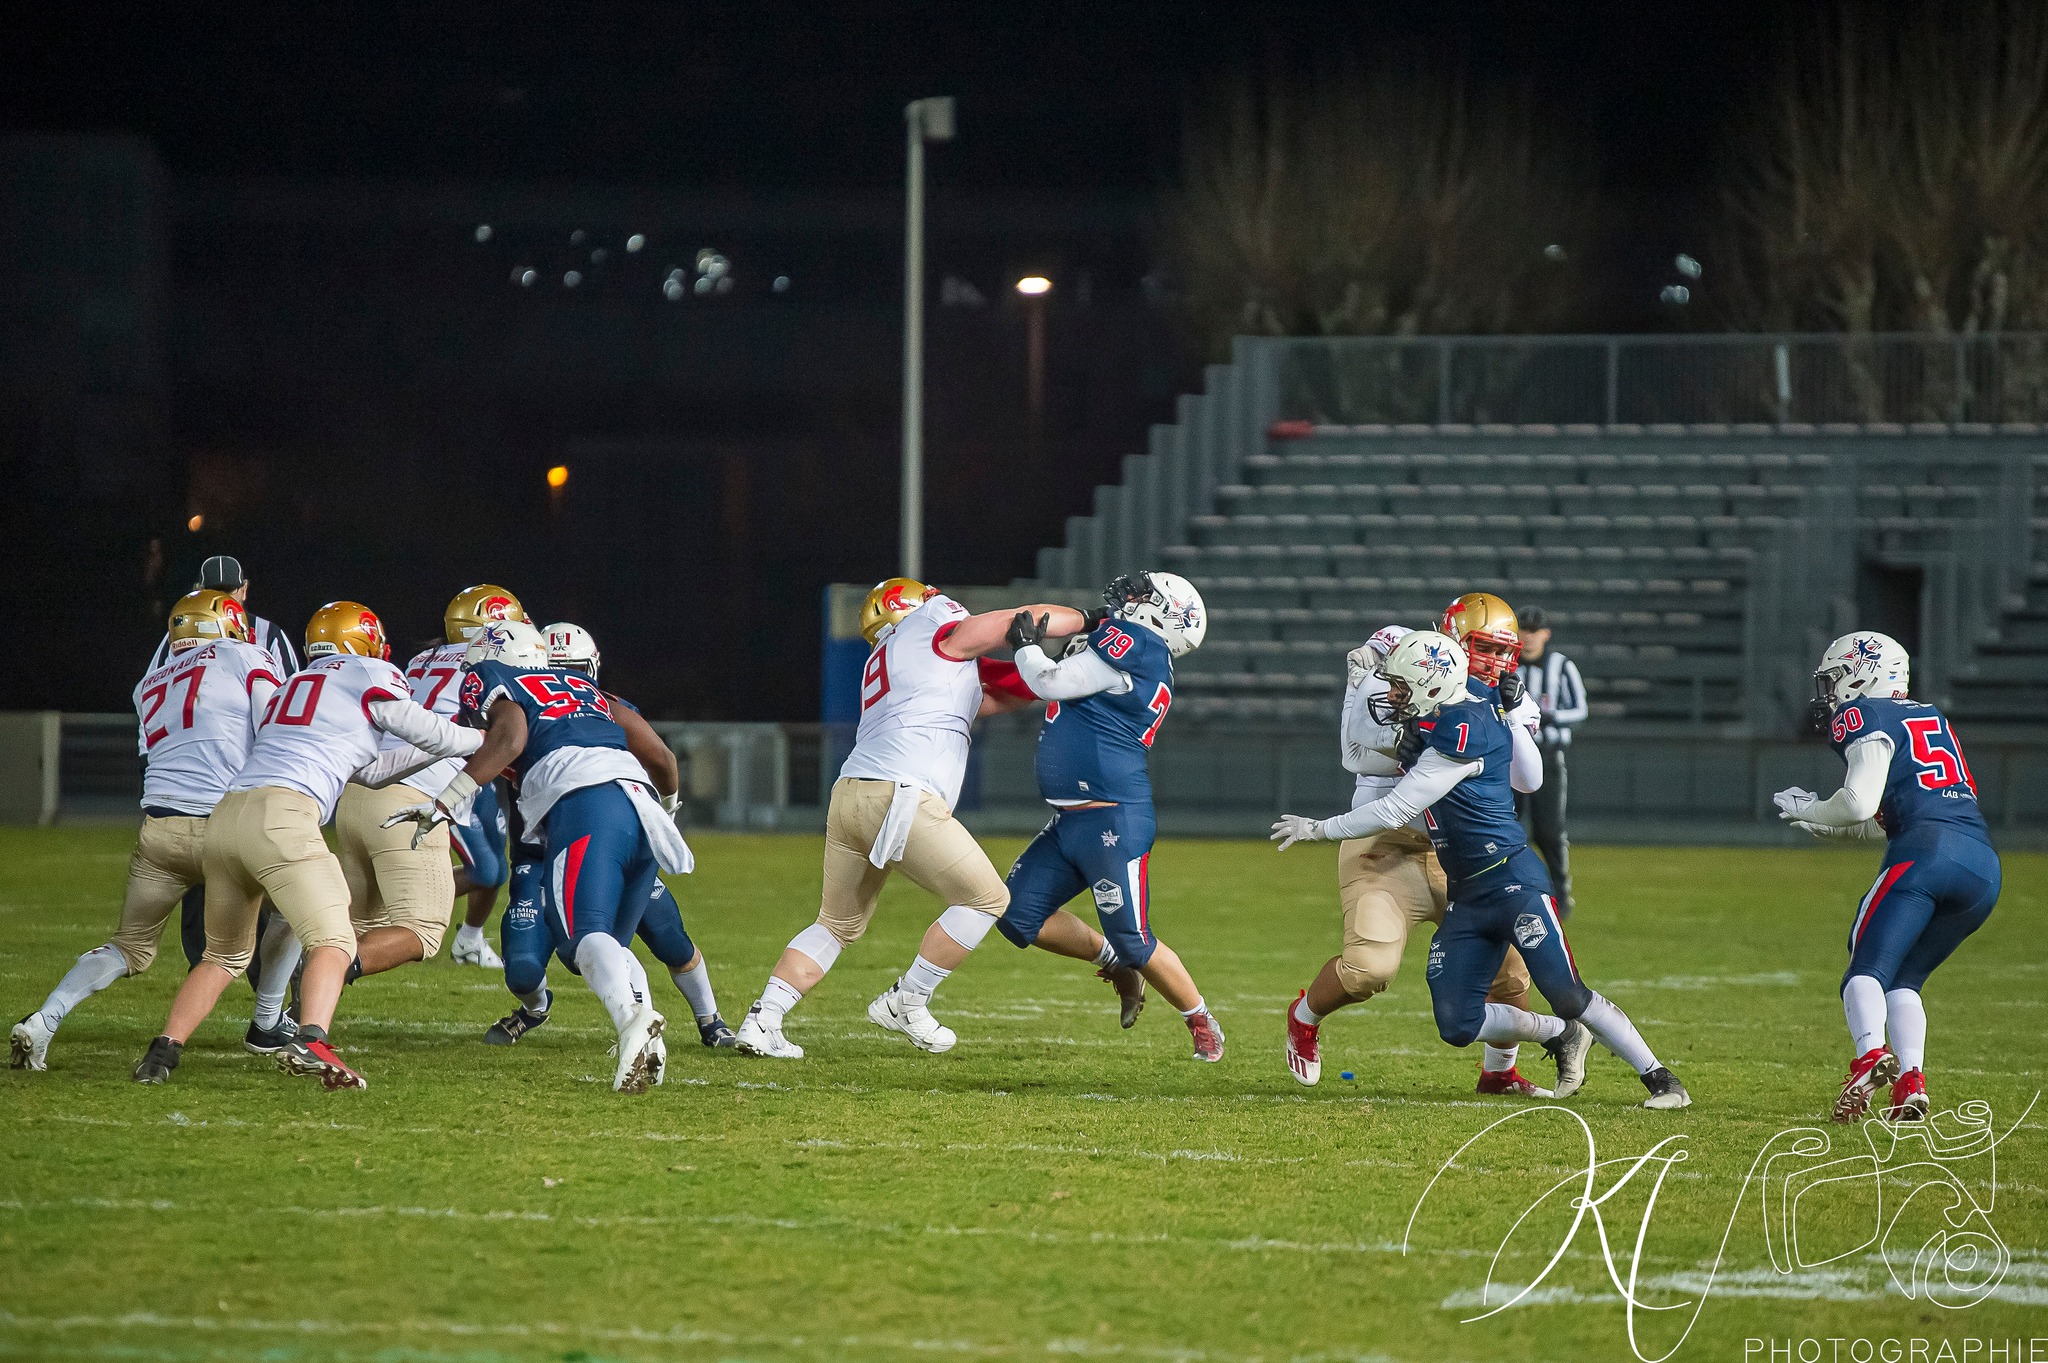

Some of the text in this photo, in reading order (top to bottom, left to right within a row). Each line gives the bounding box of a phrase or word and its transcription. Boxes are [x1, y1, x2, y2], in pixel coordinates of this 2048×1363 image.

[171, 639, 198, 650] Riddell
[1098, 625, 1134, 660] 79
[141, 665, 207, 749] 27
[1455, 722, 1470, 754] 1
[1831, 706, 1865, 742] 50
[1942, 789, 1959, 799] LAB
